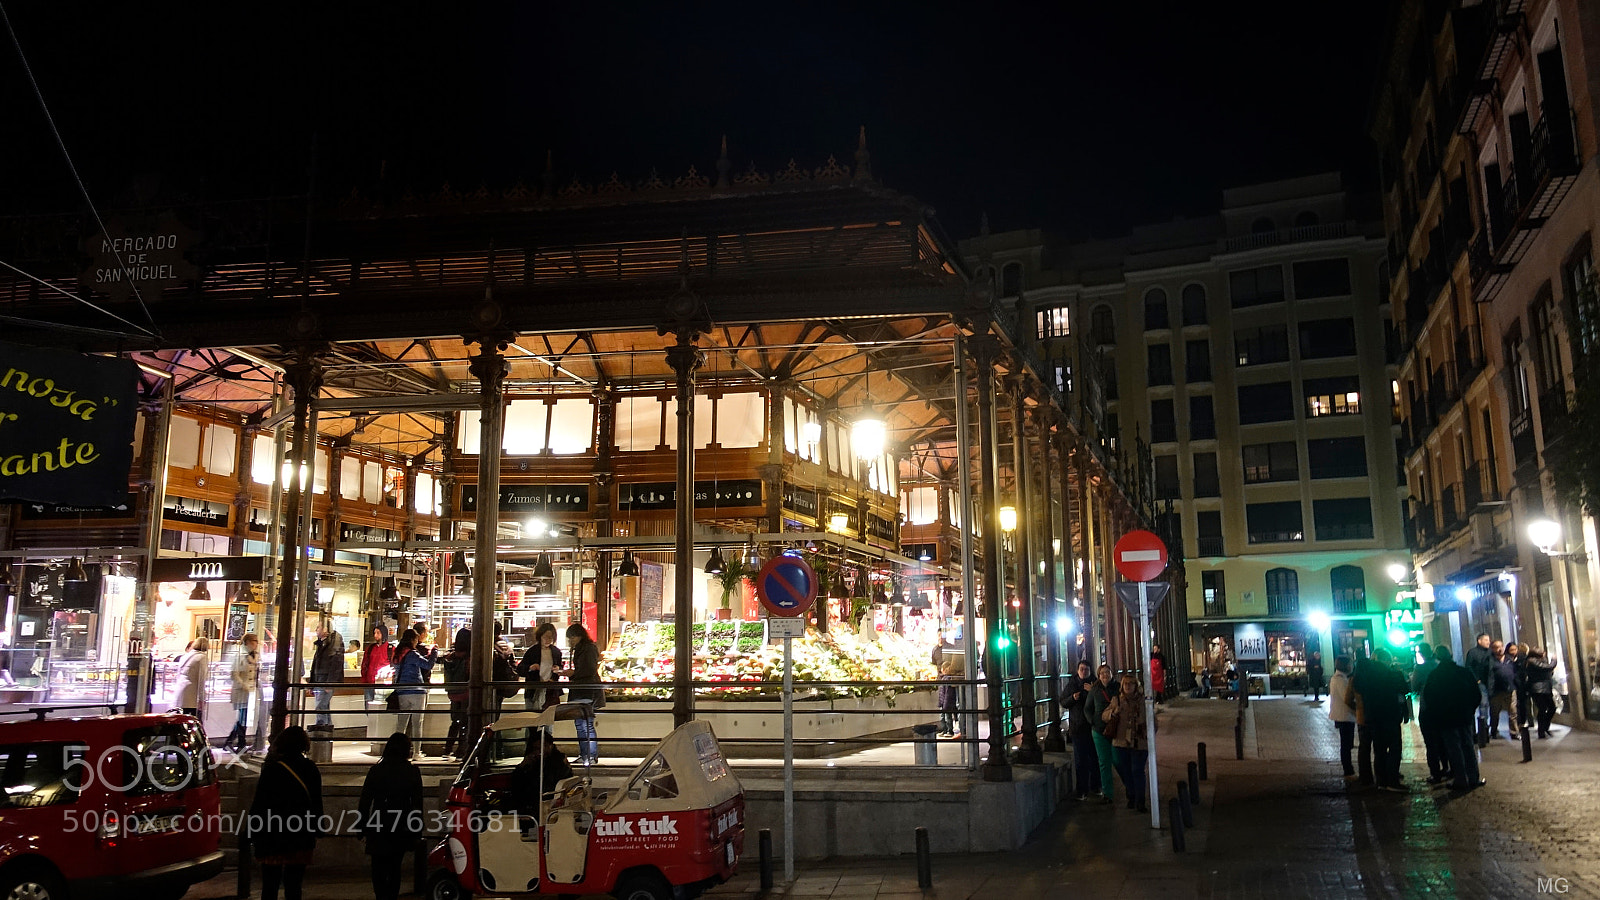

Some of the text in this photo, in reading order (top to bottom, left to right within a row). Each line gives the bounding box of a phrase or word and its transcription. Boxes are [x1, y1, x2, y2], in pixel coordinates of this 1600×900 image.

[102, 234, 177, 253] MERCADO
[128, 254, 147, 263] DE
[96, 264, 177, 283] SAN MIGUEL
[0, 437, 100, 477] ante
[508, 492, 541, 504] Zumos
[594, 815, 678, 836] tuk tuk
